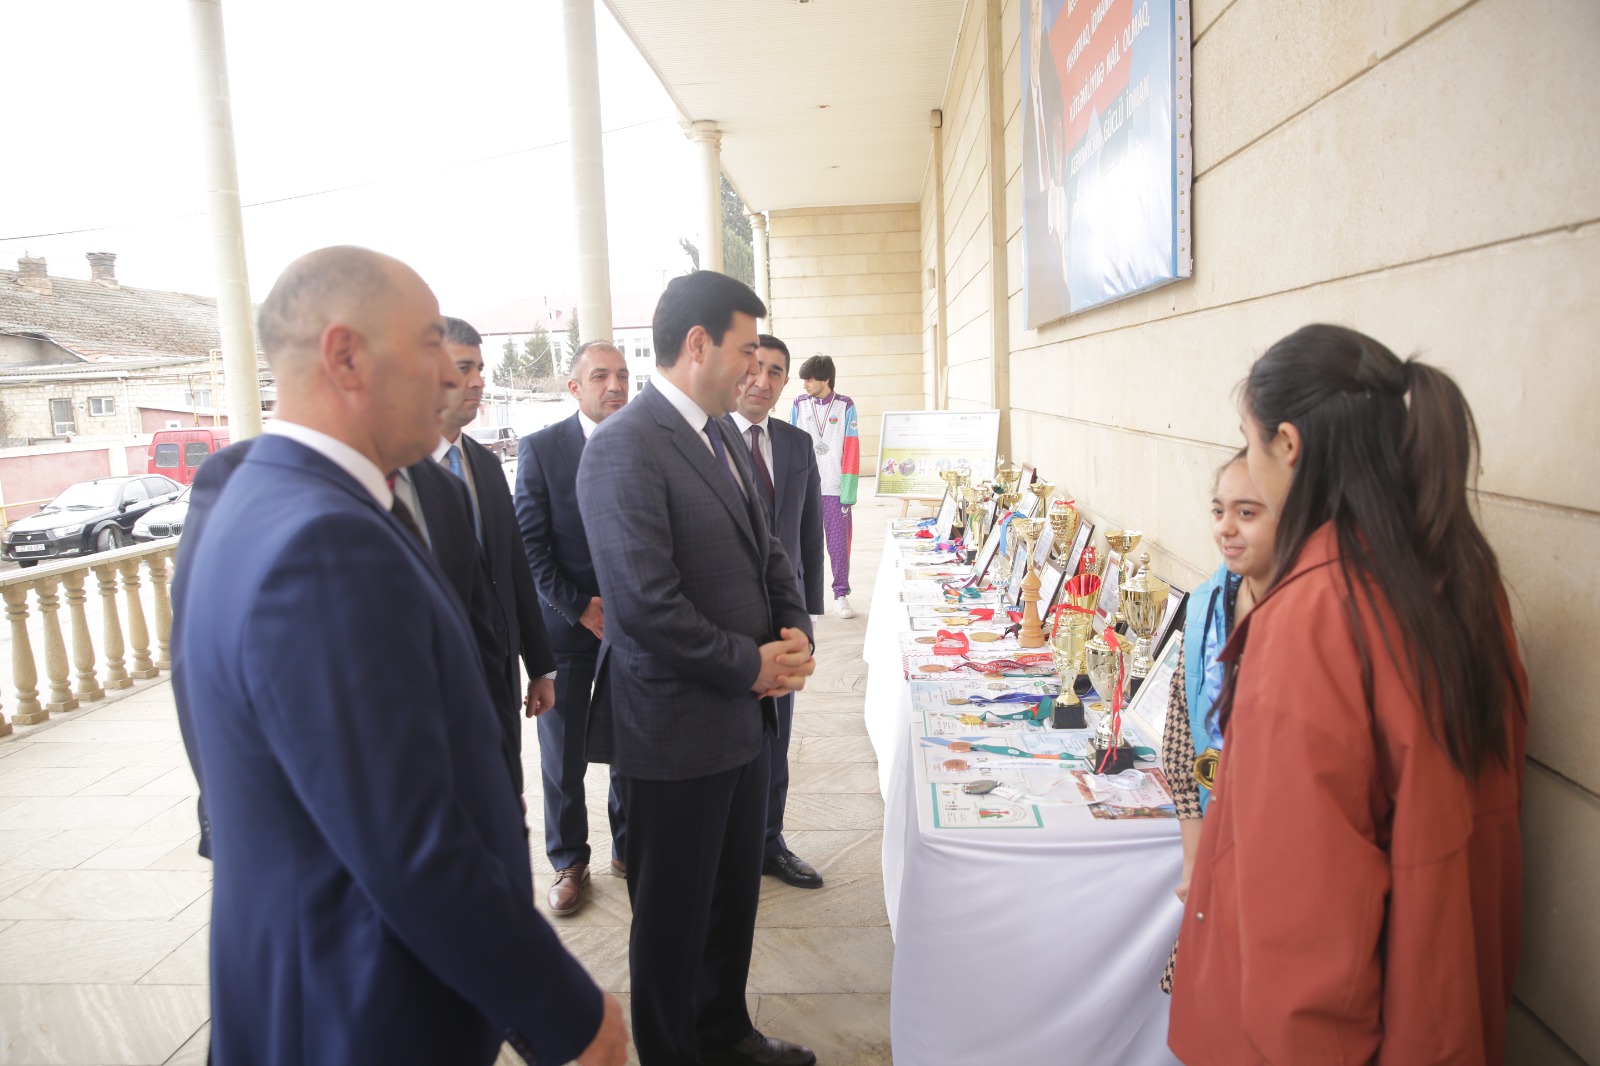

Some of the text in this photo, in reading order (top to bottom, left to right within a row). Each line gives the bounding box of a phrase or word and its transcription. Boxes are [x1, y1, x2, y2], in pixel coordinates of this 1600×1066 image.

[1106, 35, 1121, 75] NAİL
[1103, 96, 1124, 142] GÜCLÜ
[1126, 73, 1150, 119] İDMAN
